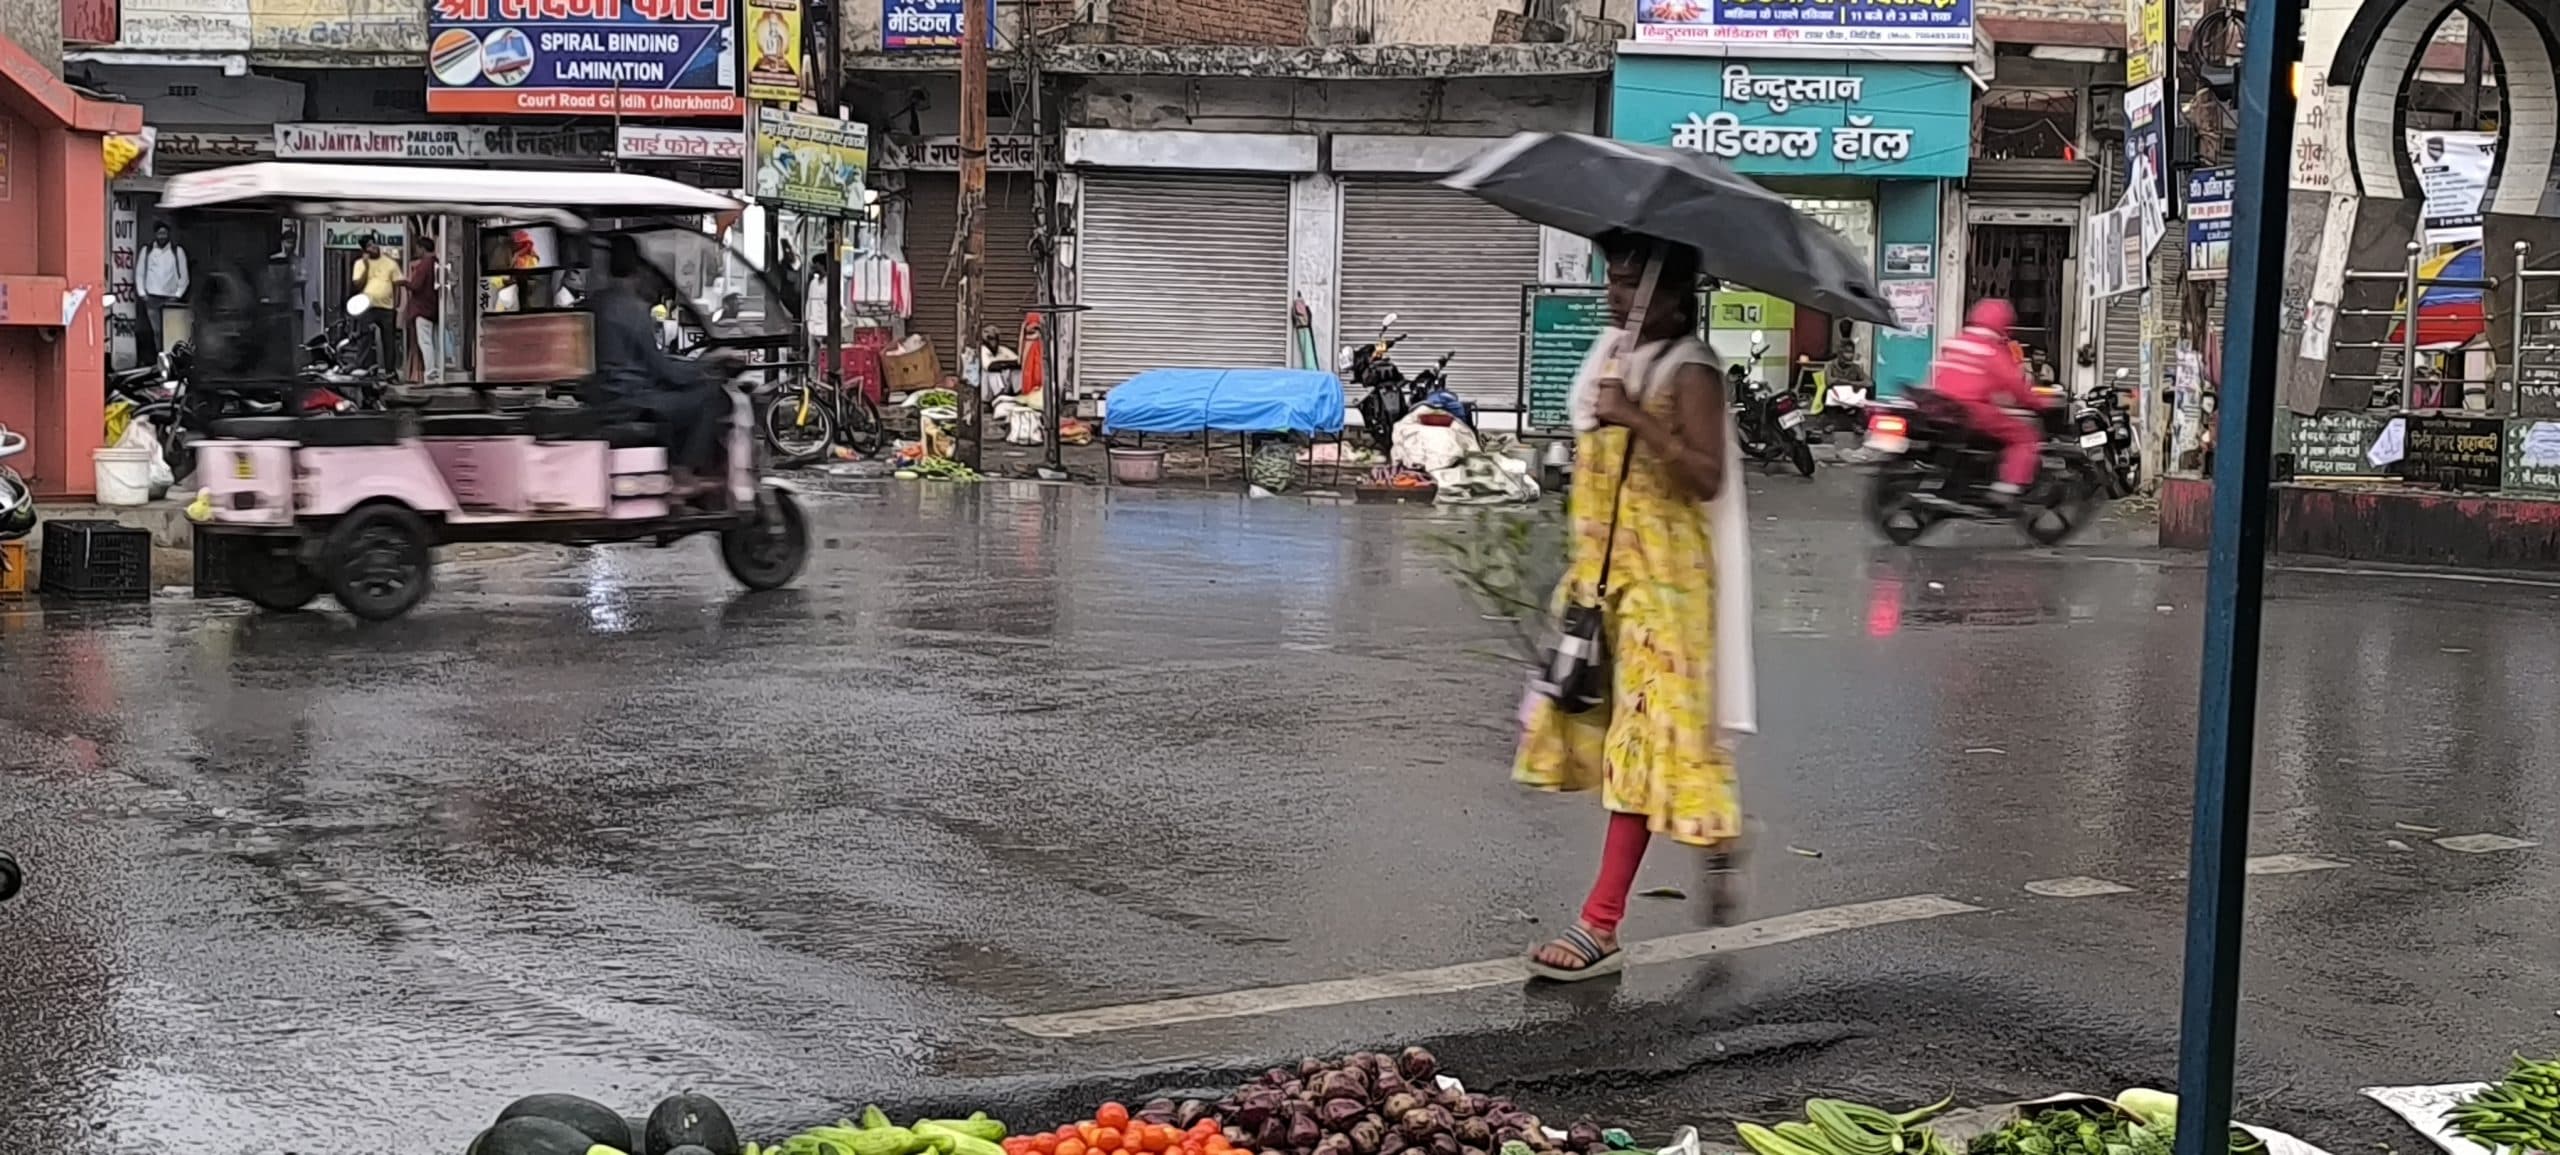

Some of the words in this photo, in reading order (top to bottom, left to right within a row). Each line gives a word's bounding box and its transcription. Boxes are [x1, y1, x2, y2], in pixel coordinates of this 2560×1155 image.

[888, 6, 952, 33] मेडिकल
[1851, 12, 1862, 21] 11
[540, 33, 604, 52] SPIRAL
[611, 34, 679, 52] BINDING
[1643, 26, 1708, 41] हिन्दुस्तान
[1714, 26, 1768, 39] मेडिकल
[1773, 26, 1800, 39] हॉल
[556, 62, 664, 81] LAMINATION
[1722, 65, 1864, 113] हिन्दुस्तान
[517, 94, 556, 108] Court
[559, 94, 595, 108] Road
[599, 95, 646, 109] Giidih
[650, 96, 735, 112] (Jharkhand)
[293, 131, 317, 151] JAI
[319, 131, 362, 151] JANTA
[365, 132, 404, 152] JENTS
[406, 131, 460, 144] PARLOUR
[623, 133, 662, 156] साई
[664, 135, 709, 155] फोटो
[1670, 112, 1822, 158] मेडिकल
[1831, 115, 1914, 160] हॉल
[406, 145, 455, 157] SALOON
[115, 220, 134, 240] OUT
